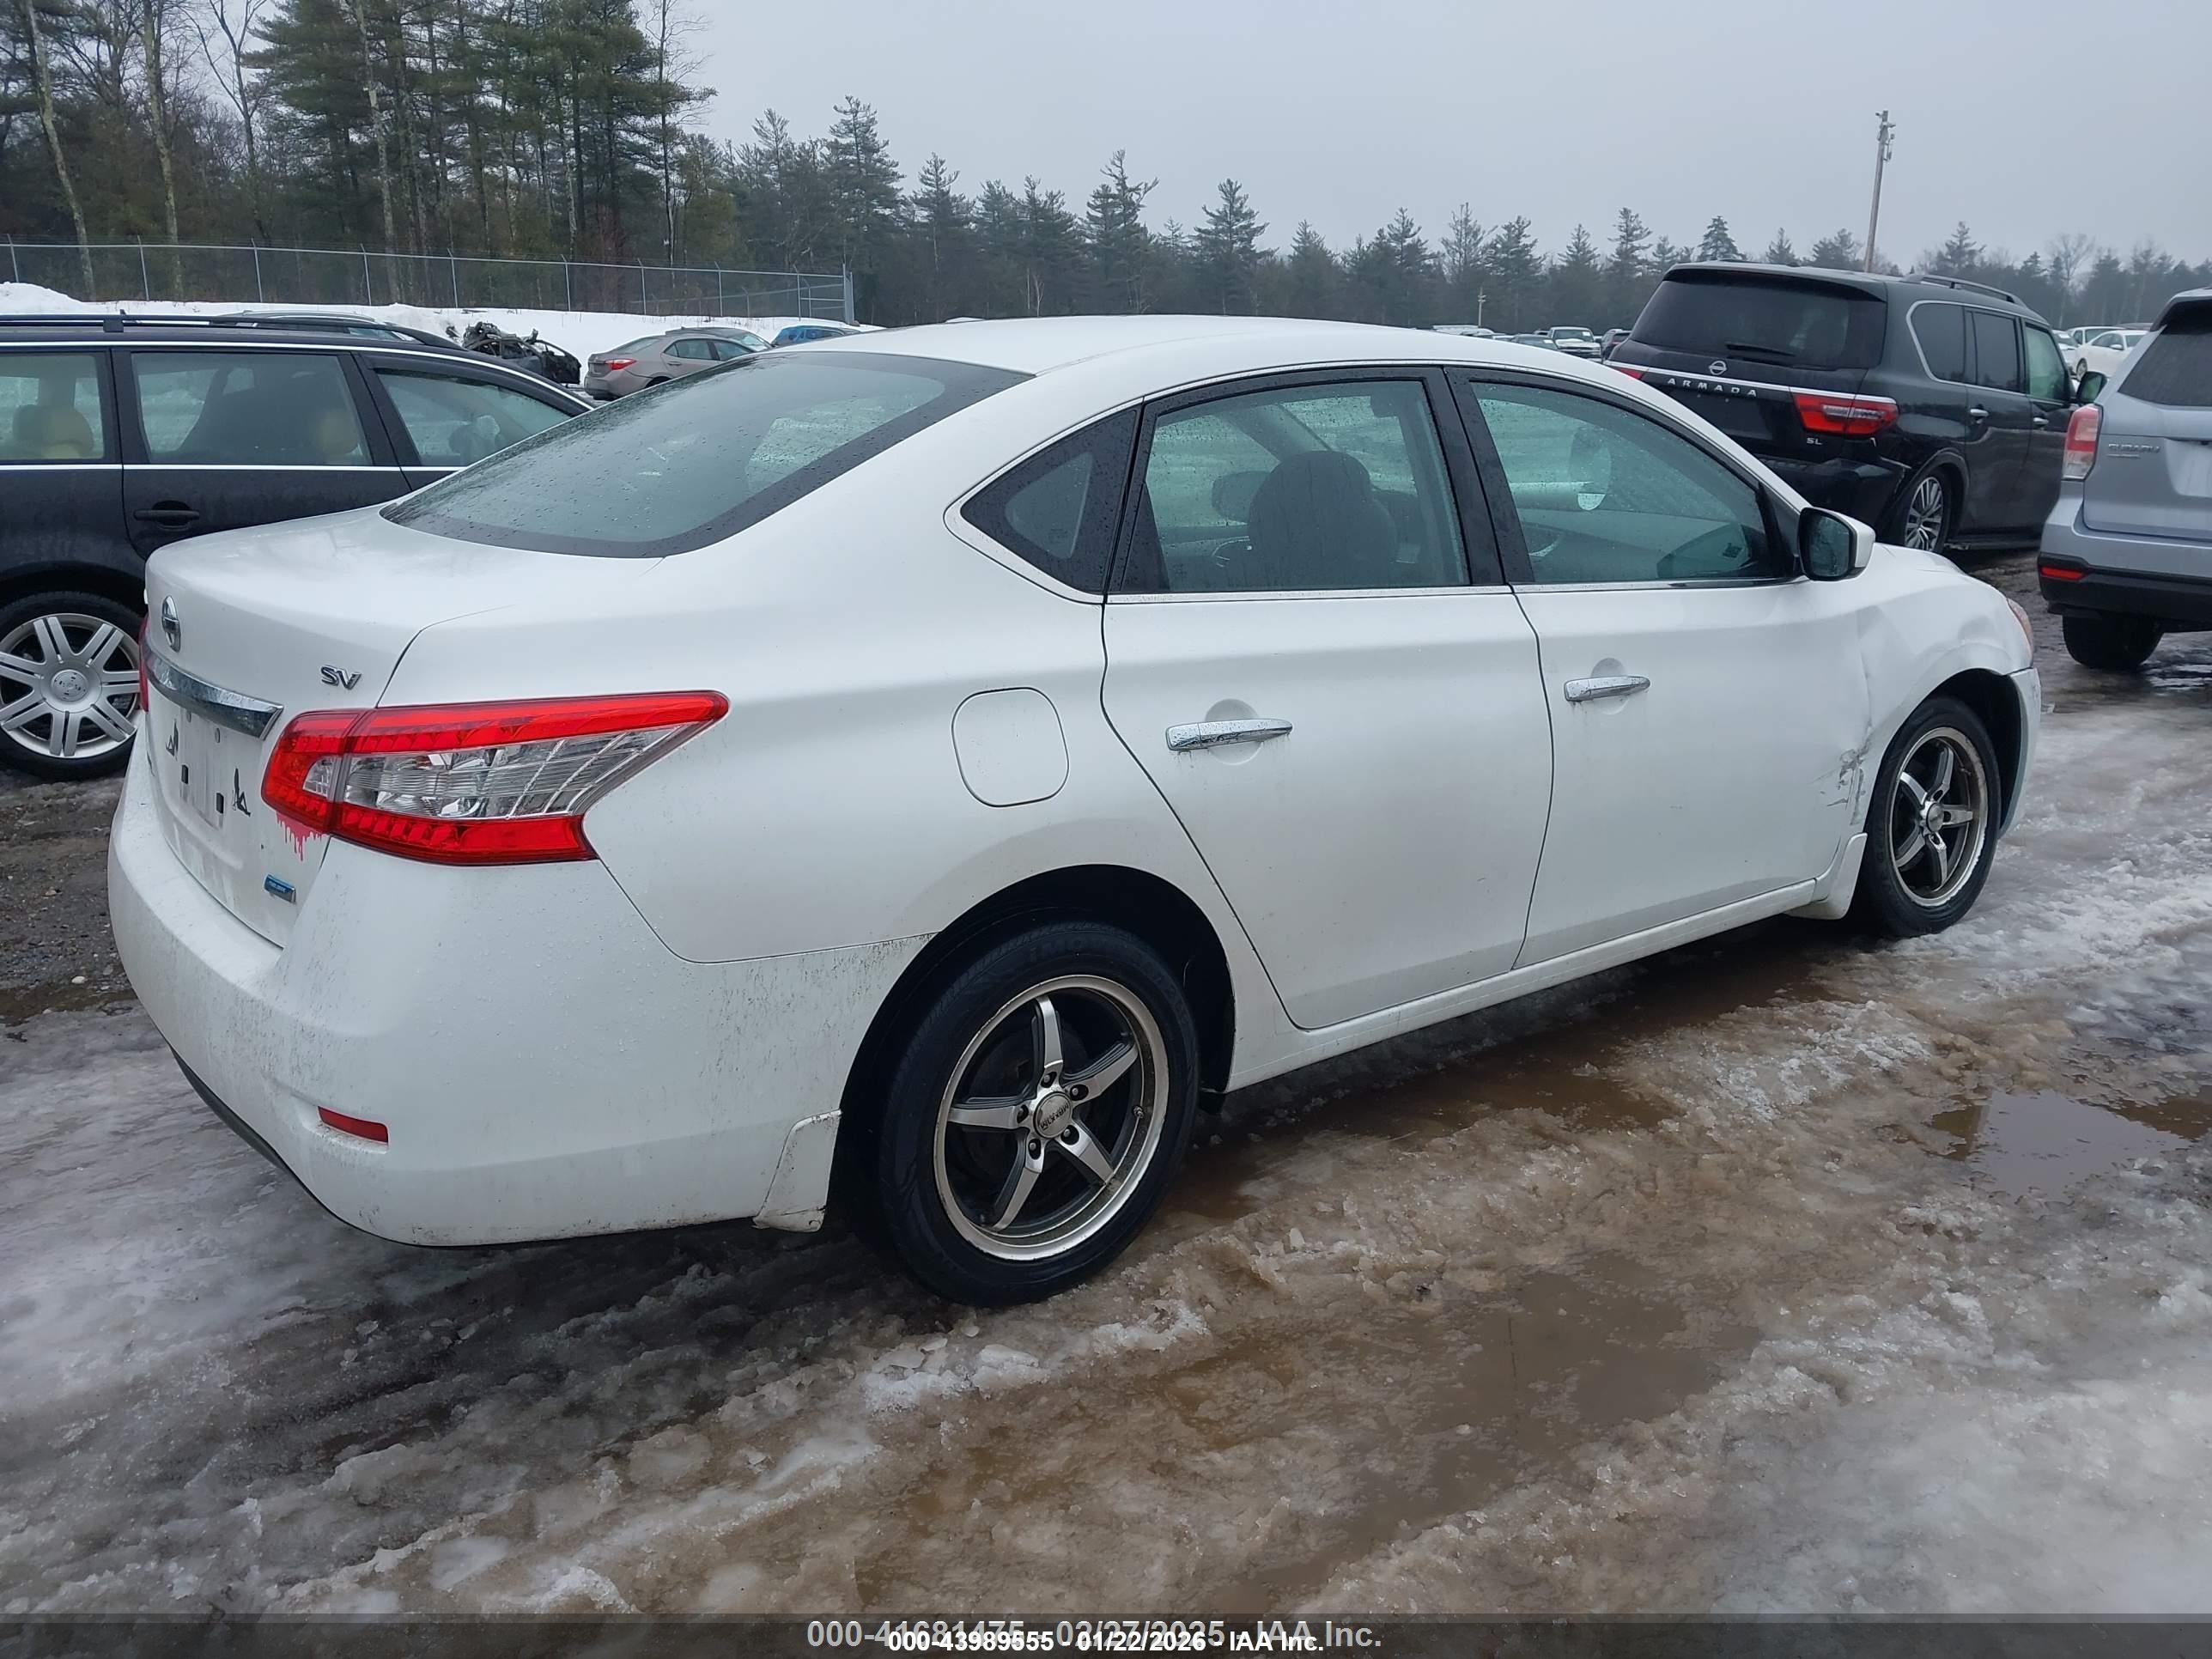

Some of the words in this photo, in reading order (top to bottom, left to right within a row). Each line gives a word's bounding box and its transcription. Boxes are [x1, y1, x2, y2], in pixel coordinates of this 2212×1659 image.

[1668, 378, 1757, 397] ARMADA
[1806, 436, 1823, 446] SL
[320, 665, 362, 690] SV
